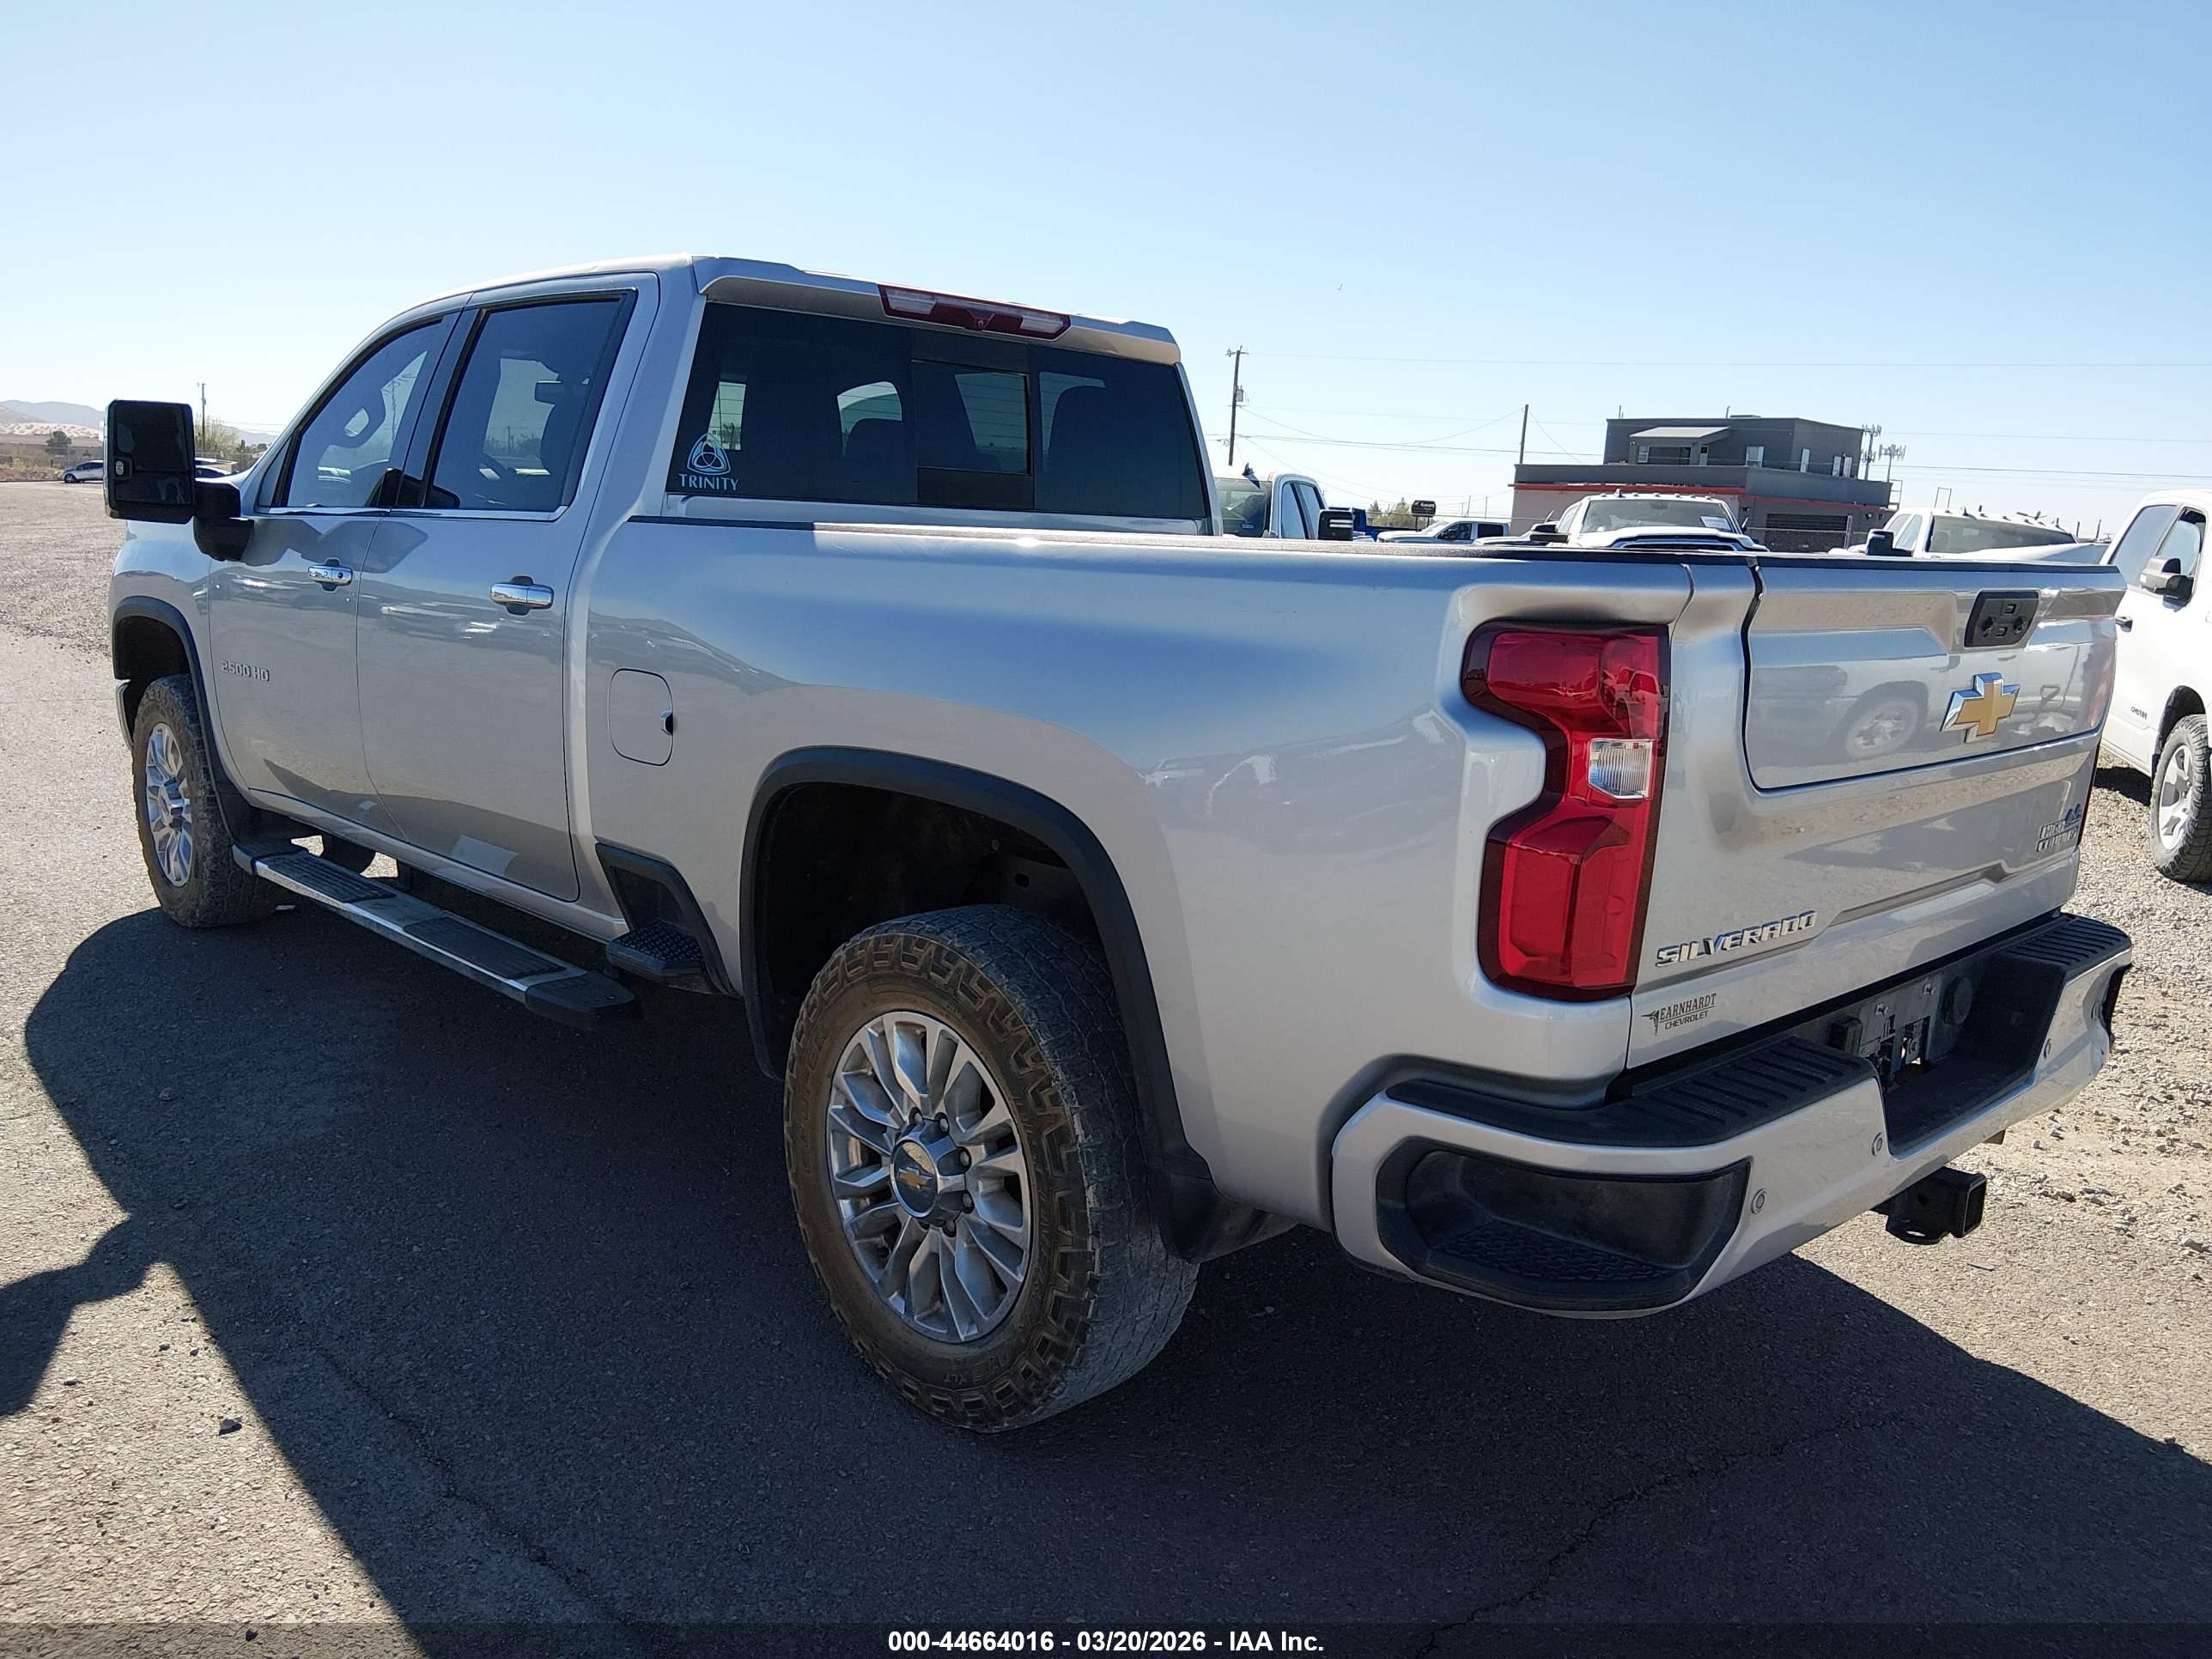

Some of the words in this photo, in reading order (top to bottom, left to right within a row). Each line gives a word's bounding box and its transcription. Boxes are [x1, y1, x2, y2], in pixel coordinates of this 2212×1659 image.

[678, 473, 738, 491] TRINITY
[221, 659, 252, 678] 2500
[253, 665, 270, 682] HD
[1655, 909, 1818, 967] SILVERADO
[1659, 993, 1717, 1021] EARNHARDT
[1664, 1010, 1709, 1030] CHEVROLET
